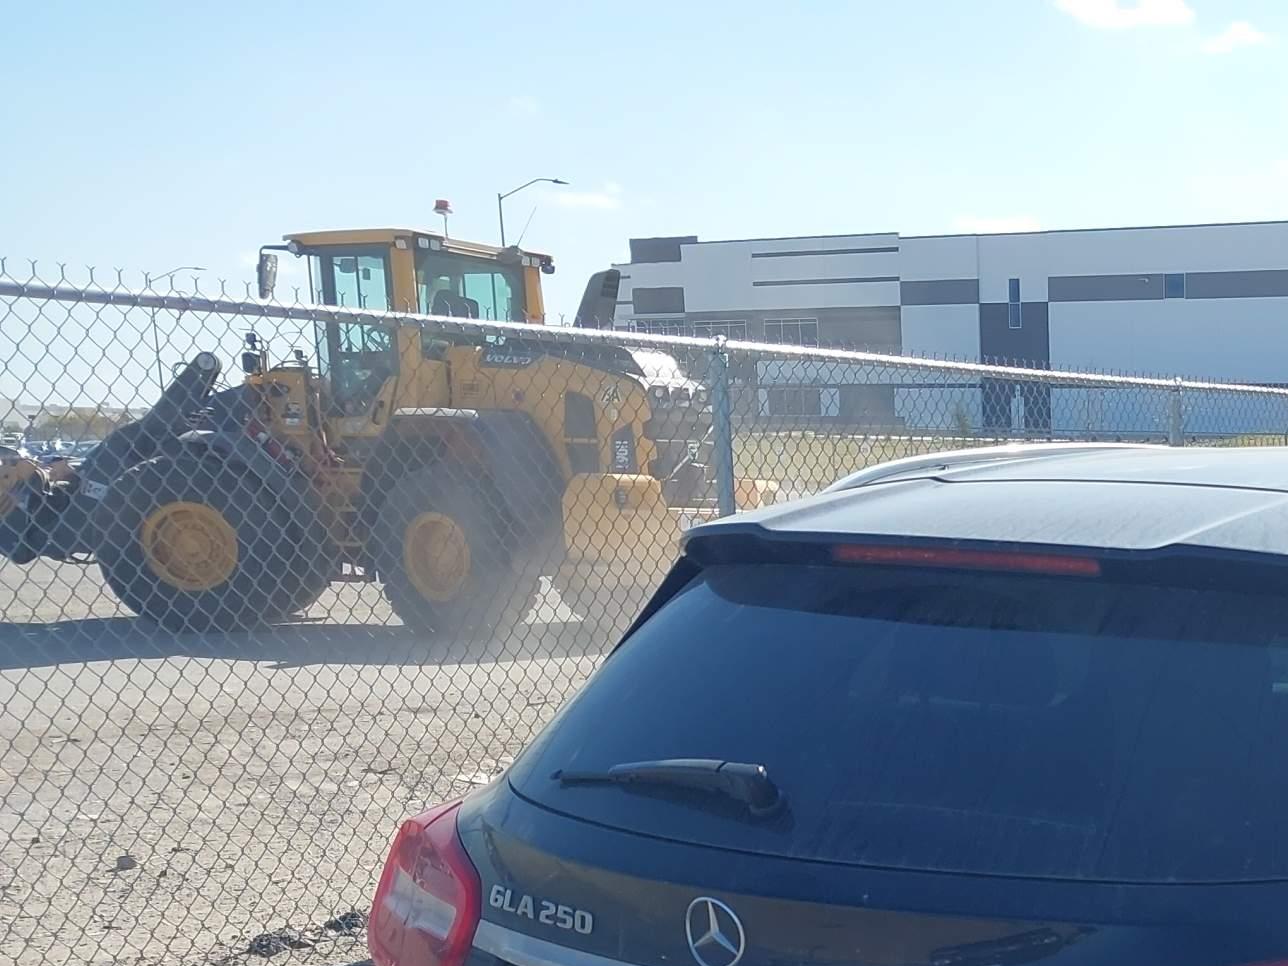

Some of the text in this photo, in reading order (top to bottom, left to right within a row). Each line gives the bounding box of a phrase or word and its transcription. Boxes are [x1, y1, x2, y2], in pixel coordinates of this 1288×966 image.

[486, 353, 531, 366] VOLVO
[490, 884, 593, 935] GLA 250
